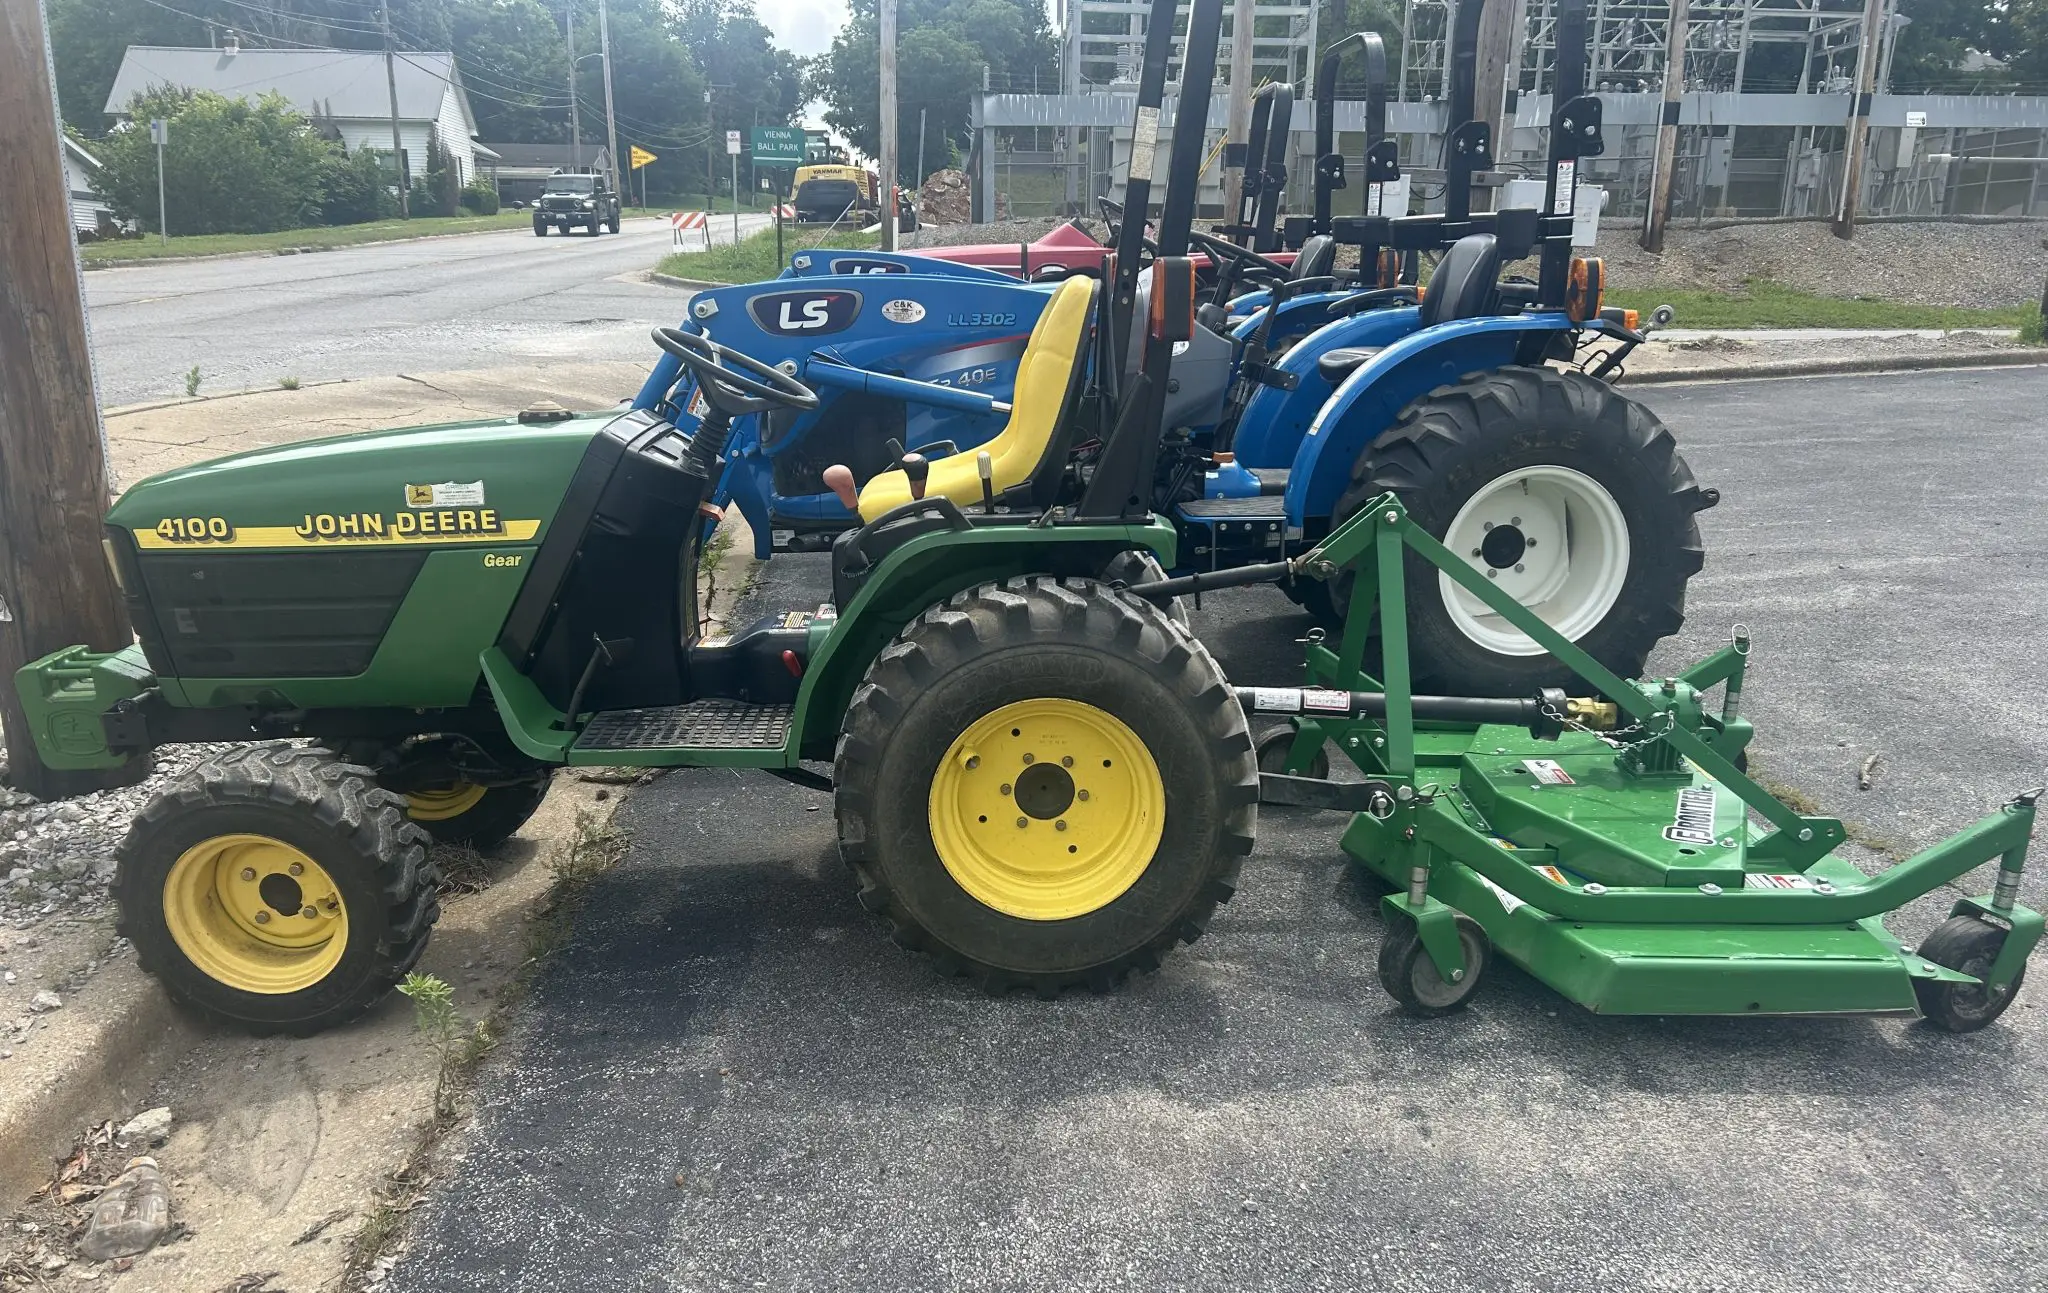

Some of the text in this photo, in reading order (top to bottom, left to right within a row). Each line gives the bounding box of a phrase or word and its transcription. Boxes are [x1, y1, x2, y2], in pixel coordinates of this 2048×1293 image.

[764, 130, 792, 140] VIENNA
[757, 142, 799, 152] BALL PARK
[893, 300, 913, 309] C&K
[778, 299, 830, 331] LS
[947, 313, 1017, 327] LL3302
[957, 367, 997, 387] 40E
[156, 516, 233, 541] 4100
[295, 508, 501, 538] JOHN DEERE
[483, 552, 523, 568] Gear
[1664, 788, 1716, 845] FRONTIER
